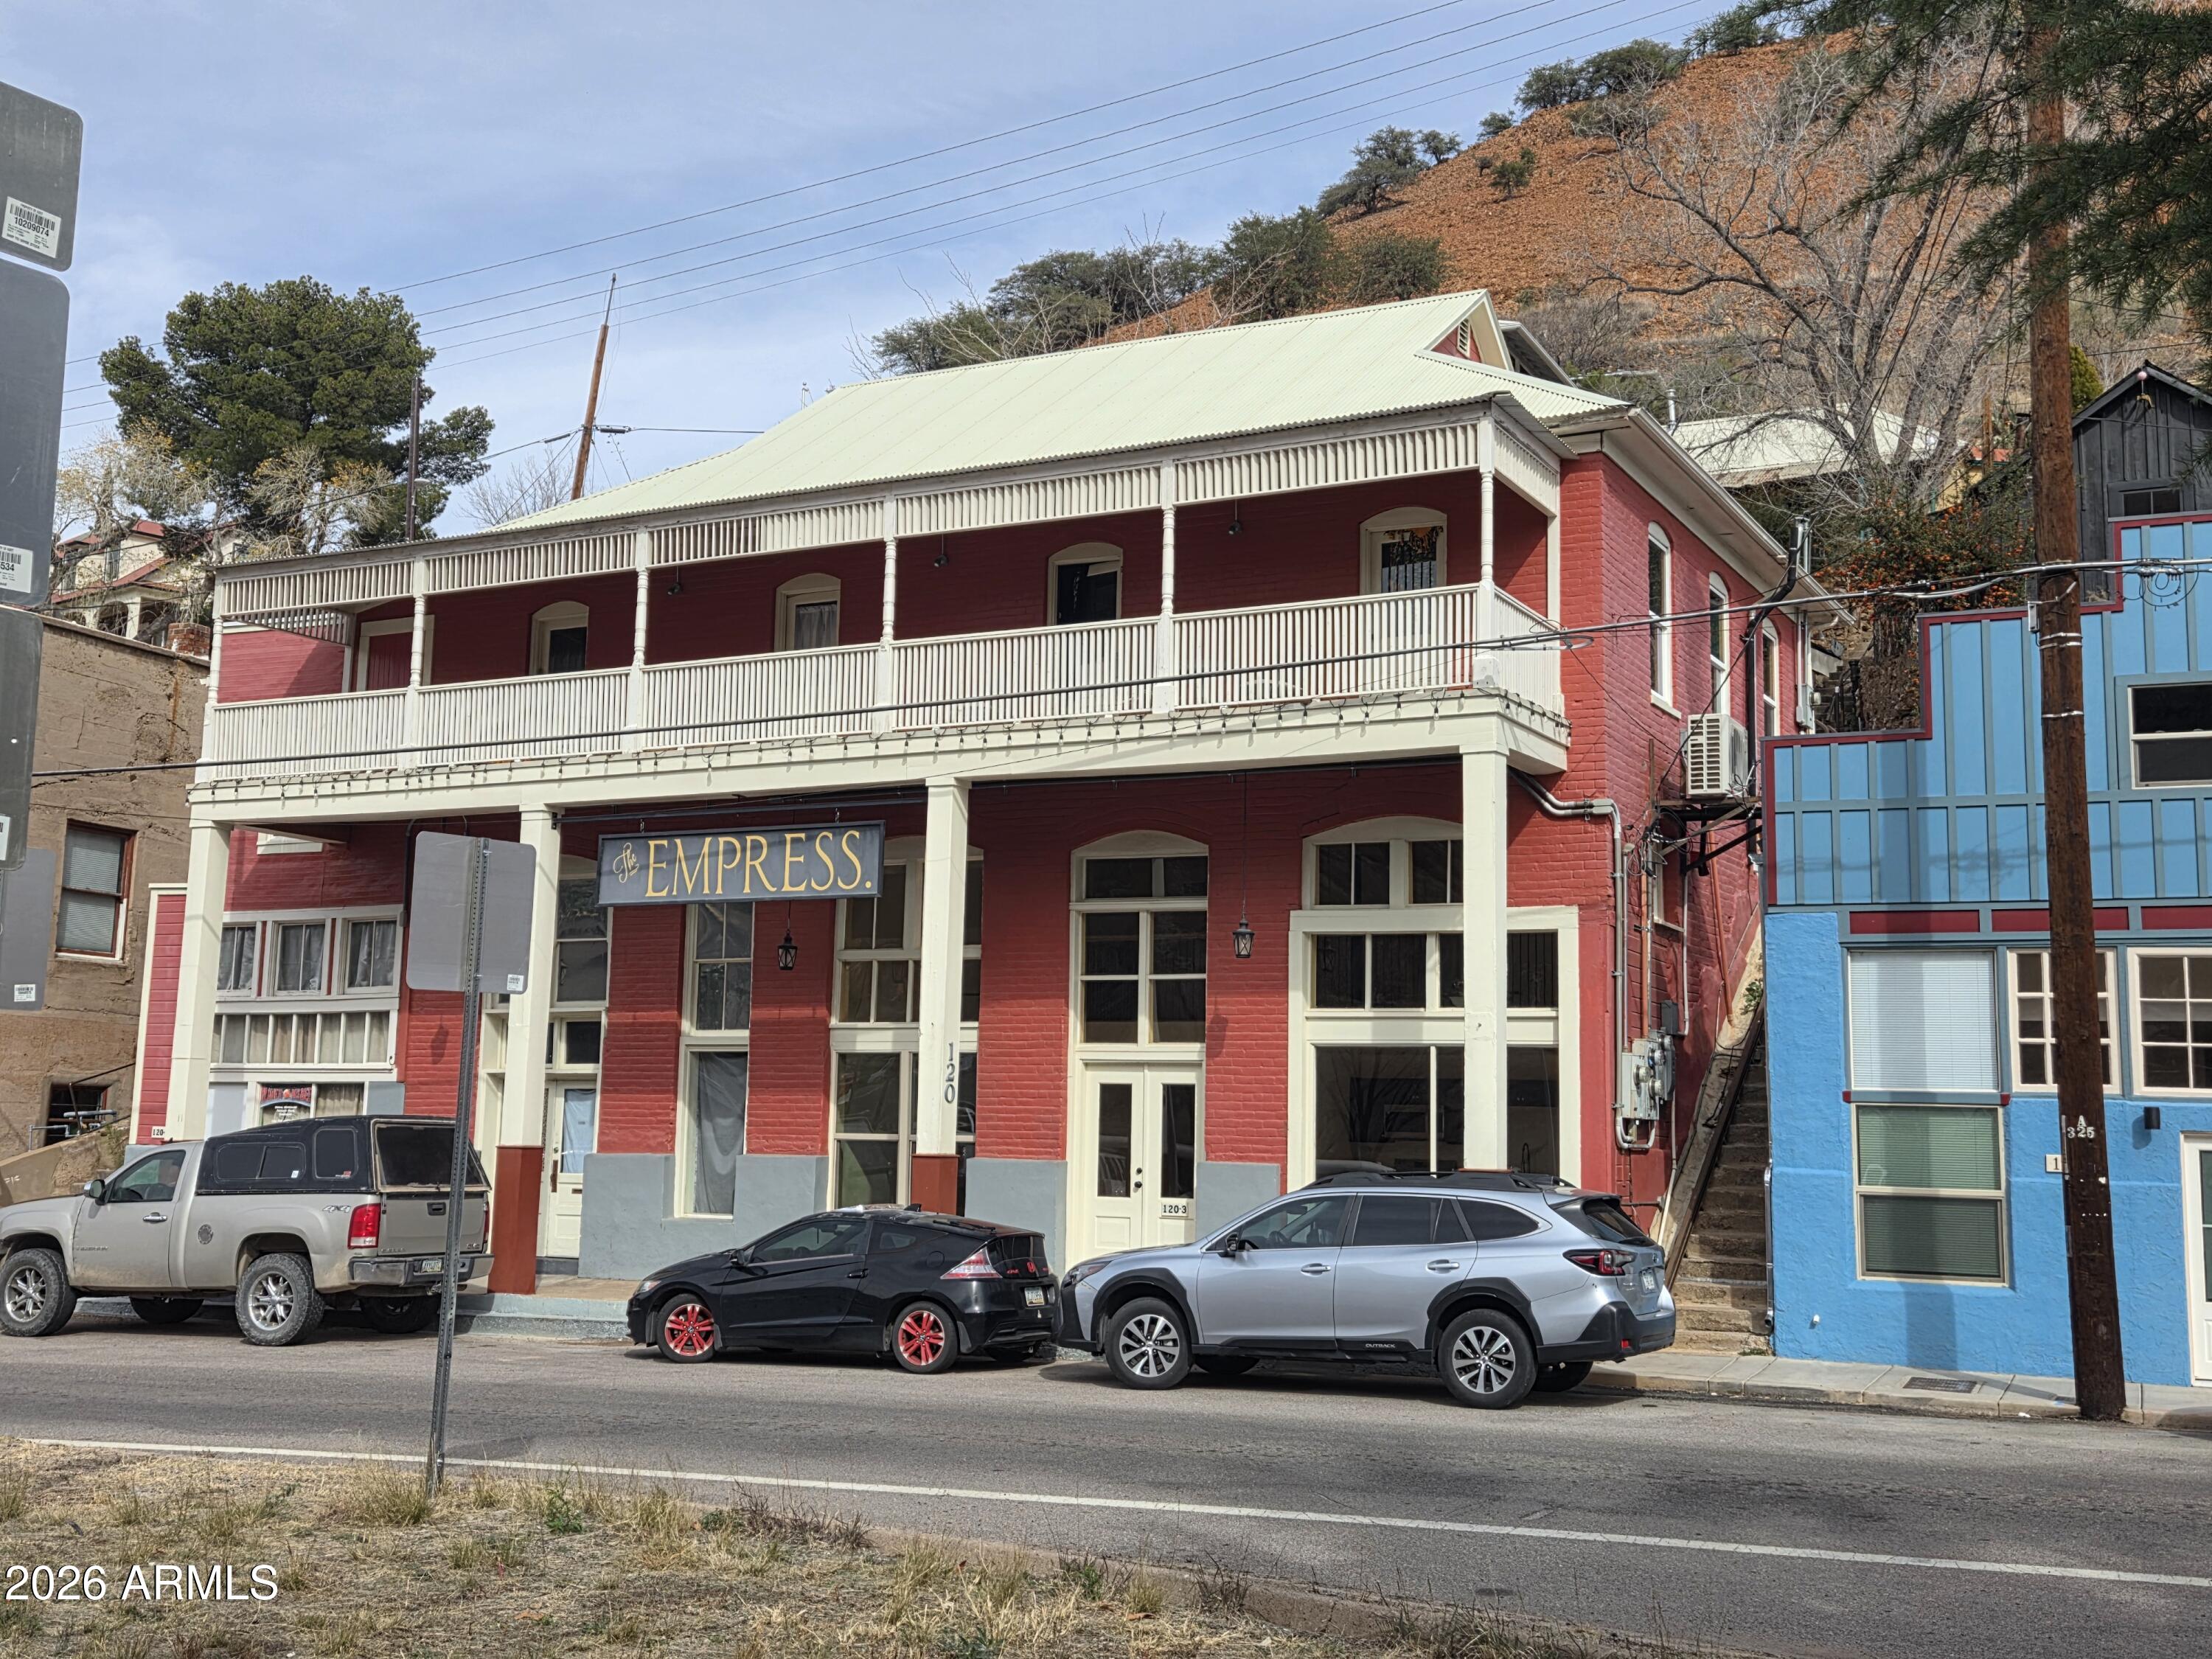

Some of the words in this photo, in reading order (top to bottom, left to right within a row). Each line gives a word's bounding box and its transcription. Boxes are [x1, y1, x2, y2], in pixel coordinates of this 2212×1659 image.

[15, 217, 49, 237] 10209074
[0, 562, 15, 571] 534
[613, 842, 639, 883] The
[645, 830, 872, 897] EMPRESS.
[945, 1041, 956, 1104] 120
[2077, 1115, 2087, 1127] A
[2067, 1127, 2095, 1138] 325
